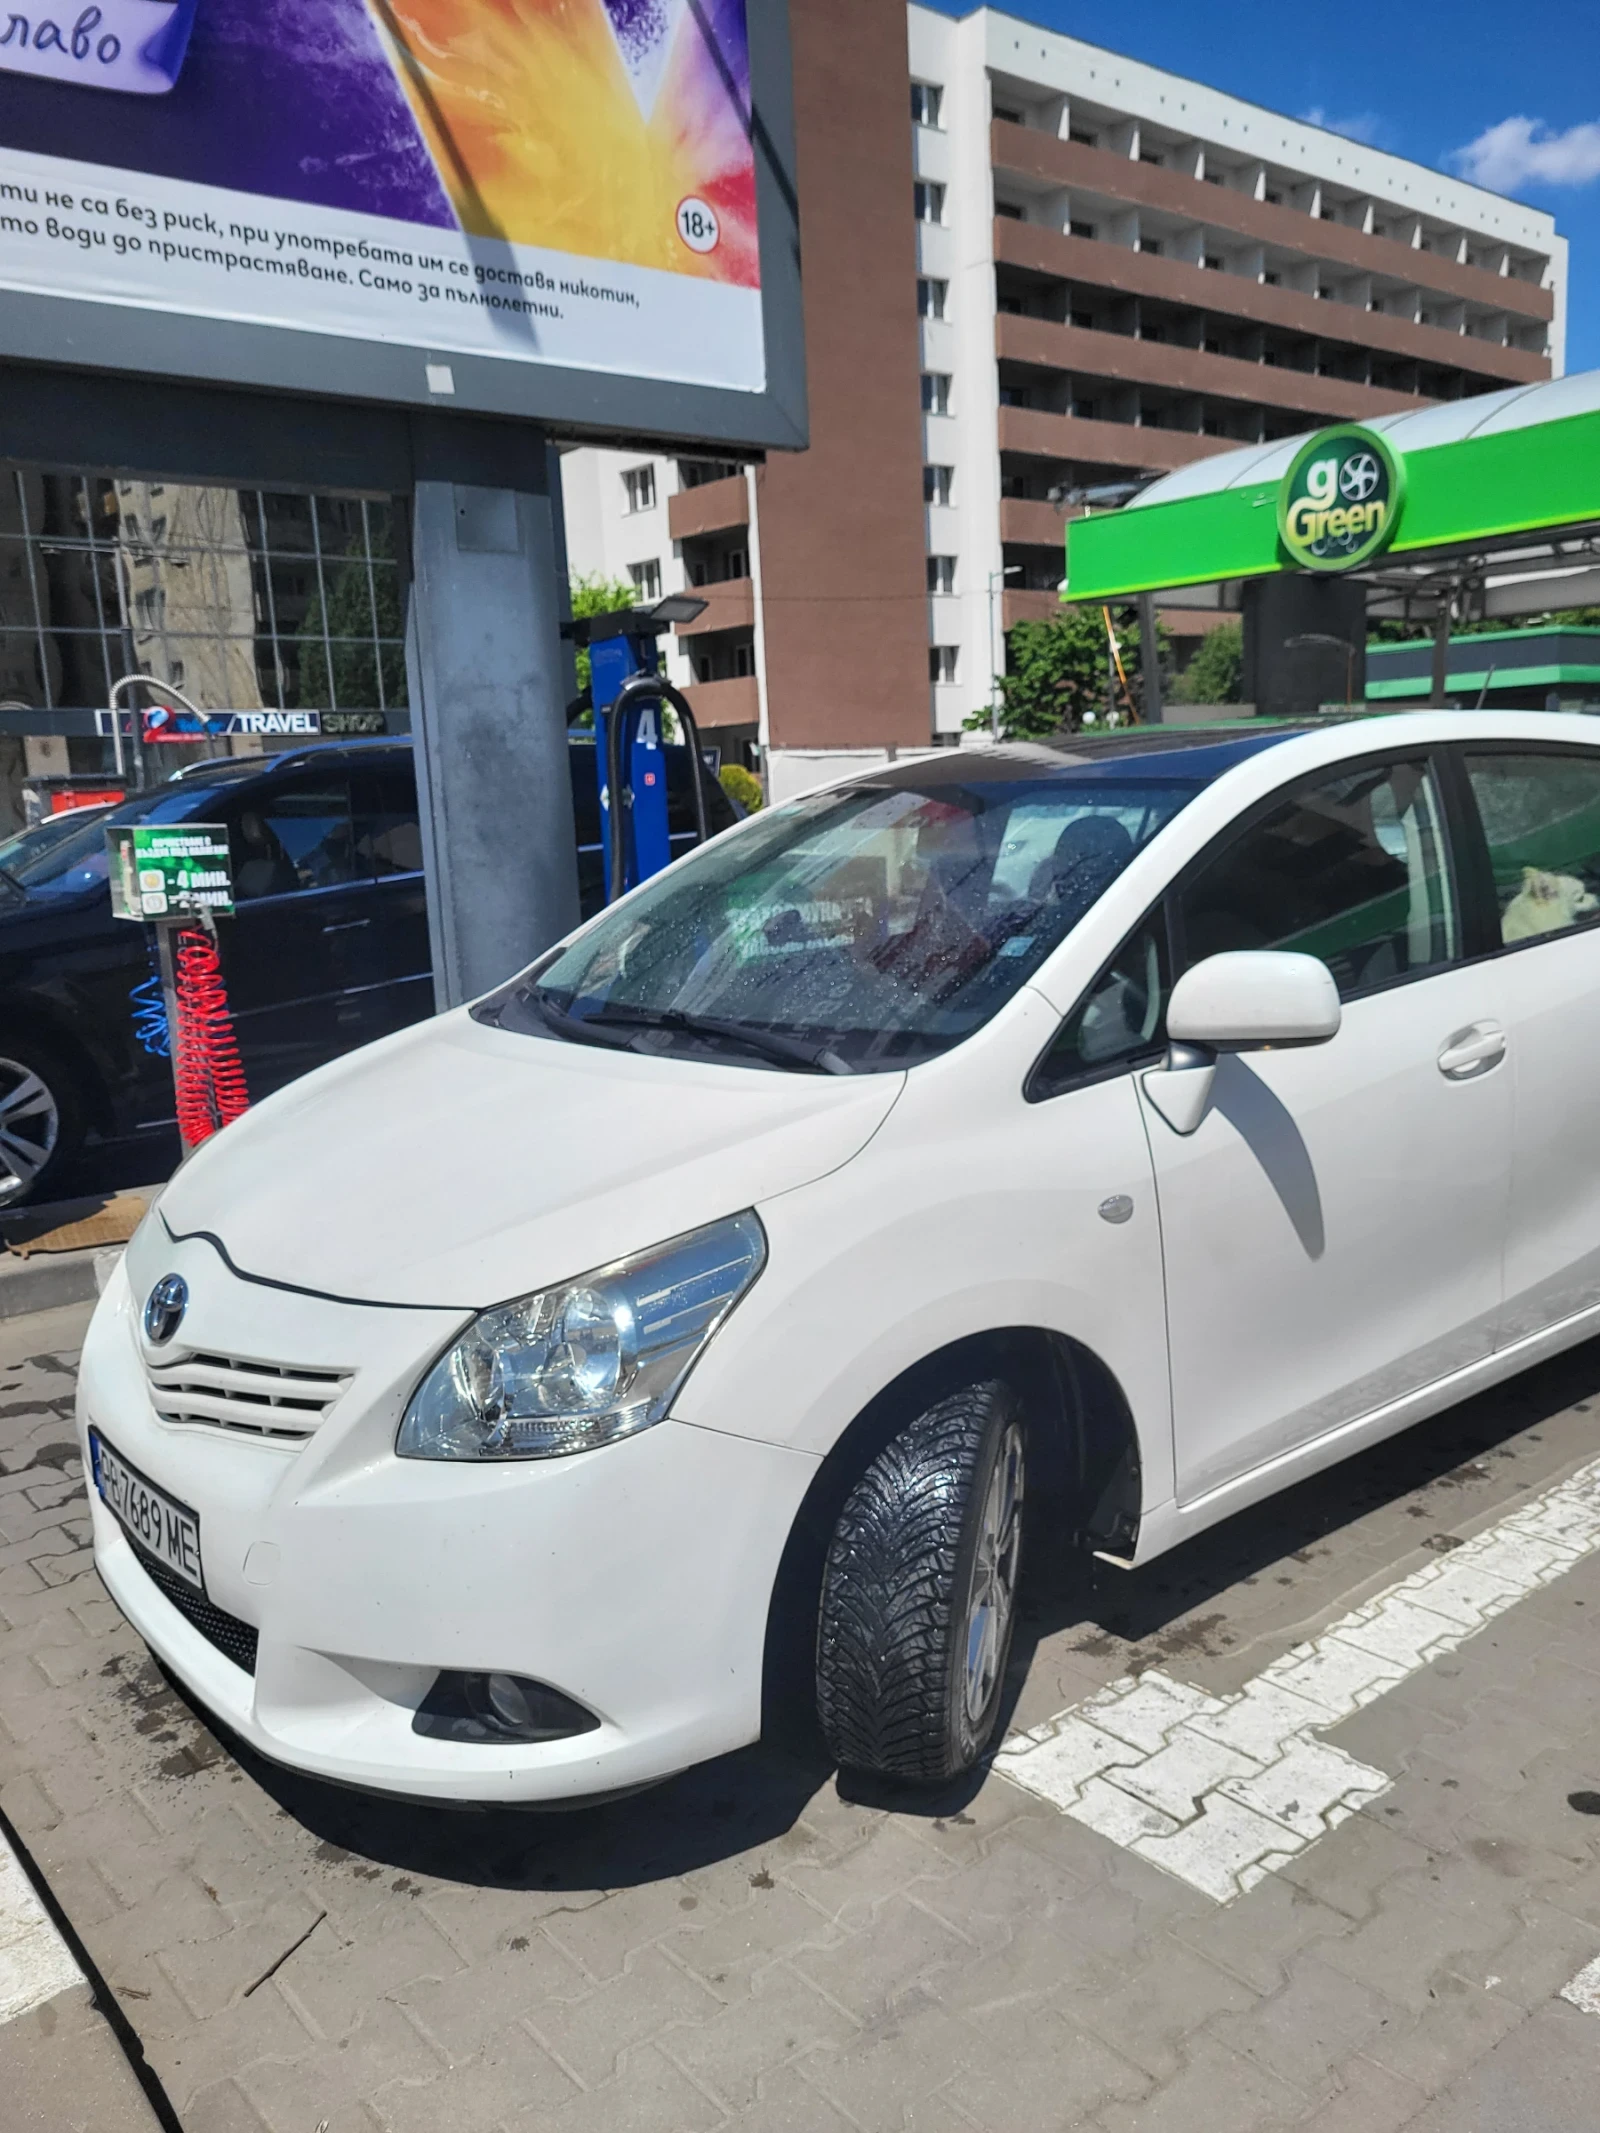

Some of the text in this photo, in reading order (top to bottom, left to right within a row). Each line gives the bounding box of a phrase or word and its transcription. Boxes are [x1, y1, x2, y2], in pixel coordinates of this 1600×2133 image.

[0, 183, 640, 309] ти не са без риск, при употребата им се доставя никотин,
[681, 210, 716, 238] 18+
[0, 215, 564, 319] то води до пристрастяване. Само за пълнолетни.
[1286, 497, 1386, 549] Green
[236, 713, 319, 734] TRAVEL
[635, 708, 659, 750] 4
